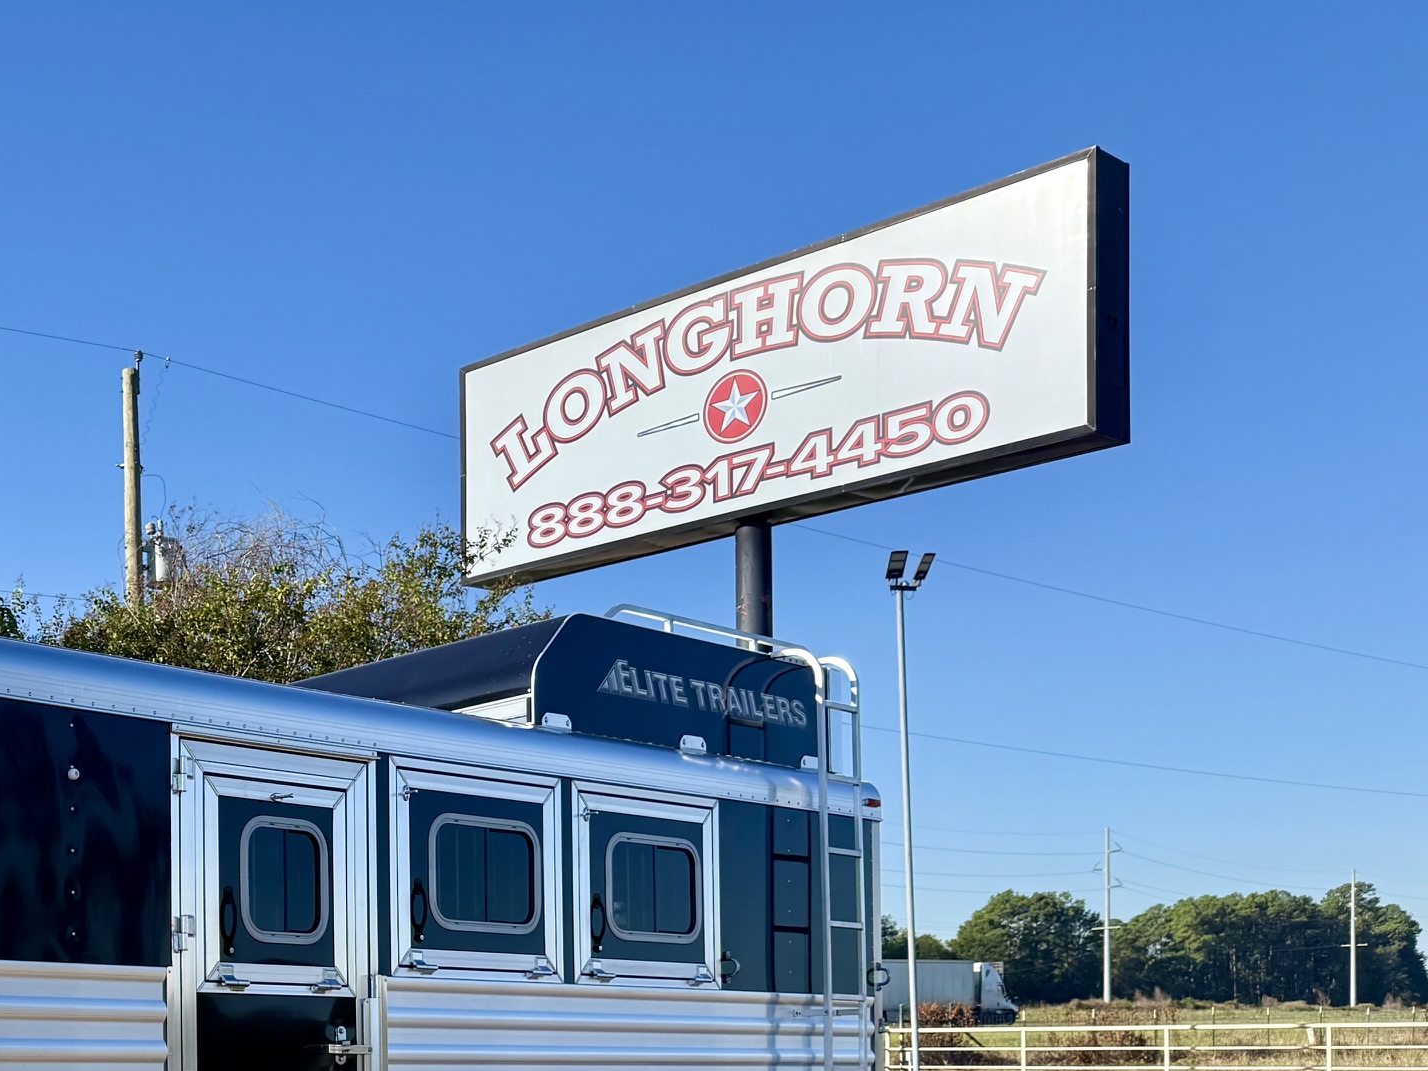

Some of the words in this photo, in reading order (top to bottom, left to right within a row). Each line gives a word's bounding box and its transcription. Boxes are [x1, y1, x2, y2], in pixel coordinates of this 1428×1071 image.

[490, 257, 1046, 491] LONGHORN
[526, 389, 990, 549] 888-317-4450
[597, 658, 689, 707] ELITE
[689, 678, 808, 728] TRAILERS
